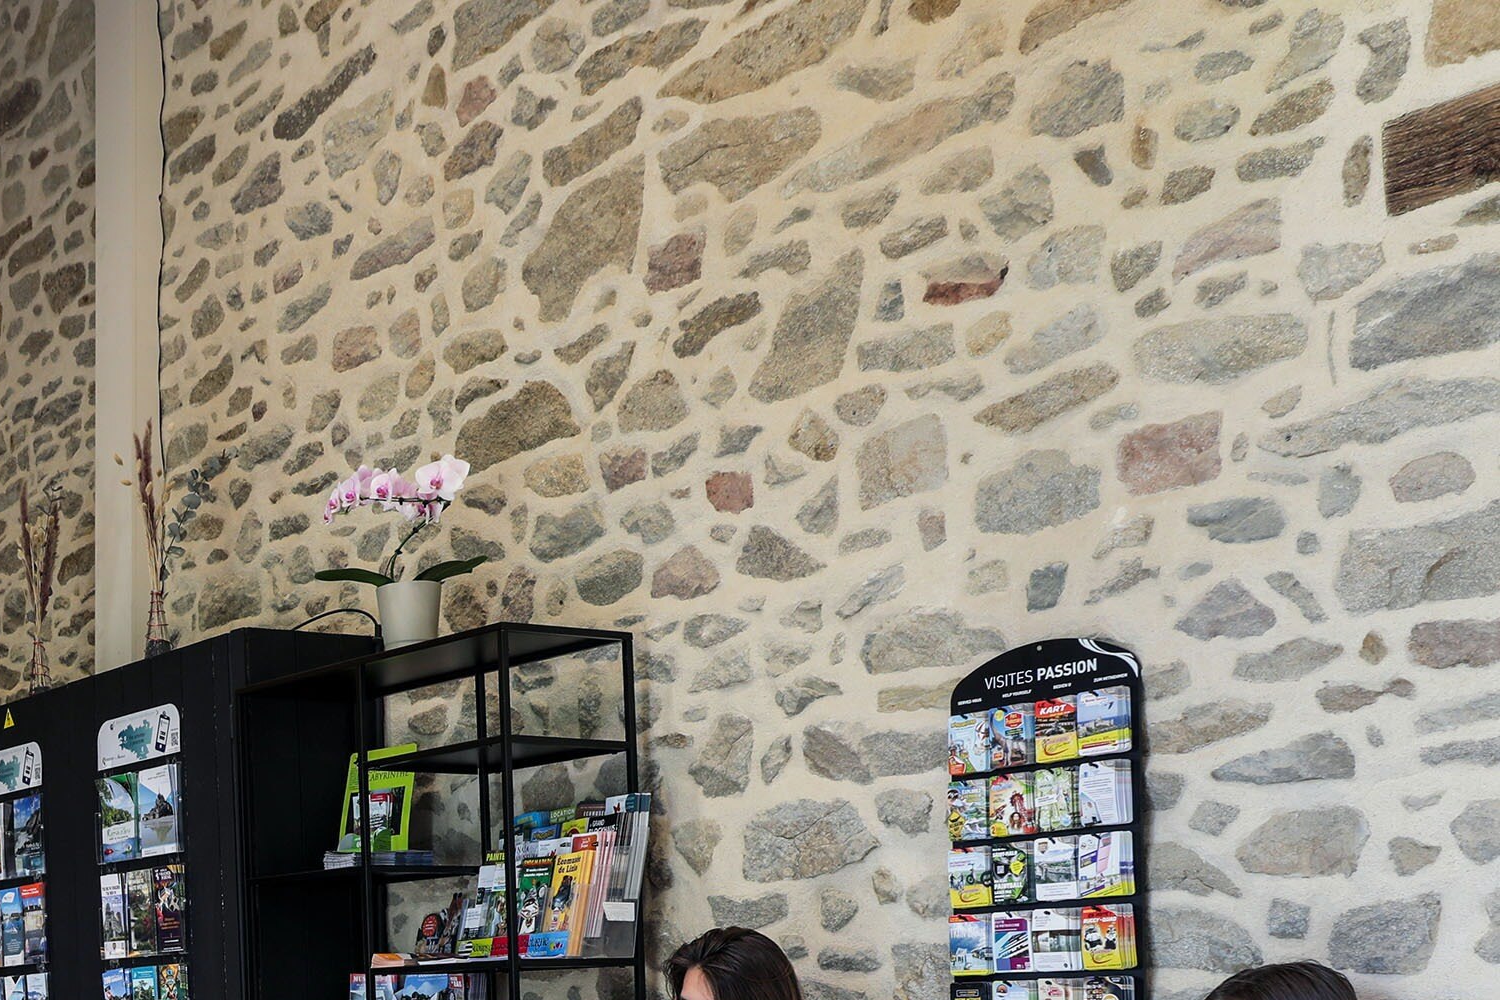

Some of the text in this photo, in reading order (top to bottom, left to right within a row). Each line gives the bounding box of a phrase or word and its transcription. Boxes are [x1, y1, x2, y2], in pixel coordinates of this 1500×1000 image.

[984, 658, 1098, 690] VISITES PASSION
[1040, 704, 1066, 715] KART
[550, 807, 575, 819] LOCATION
